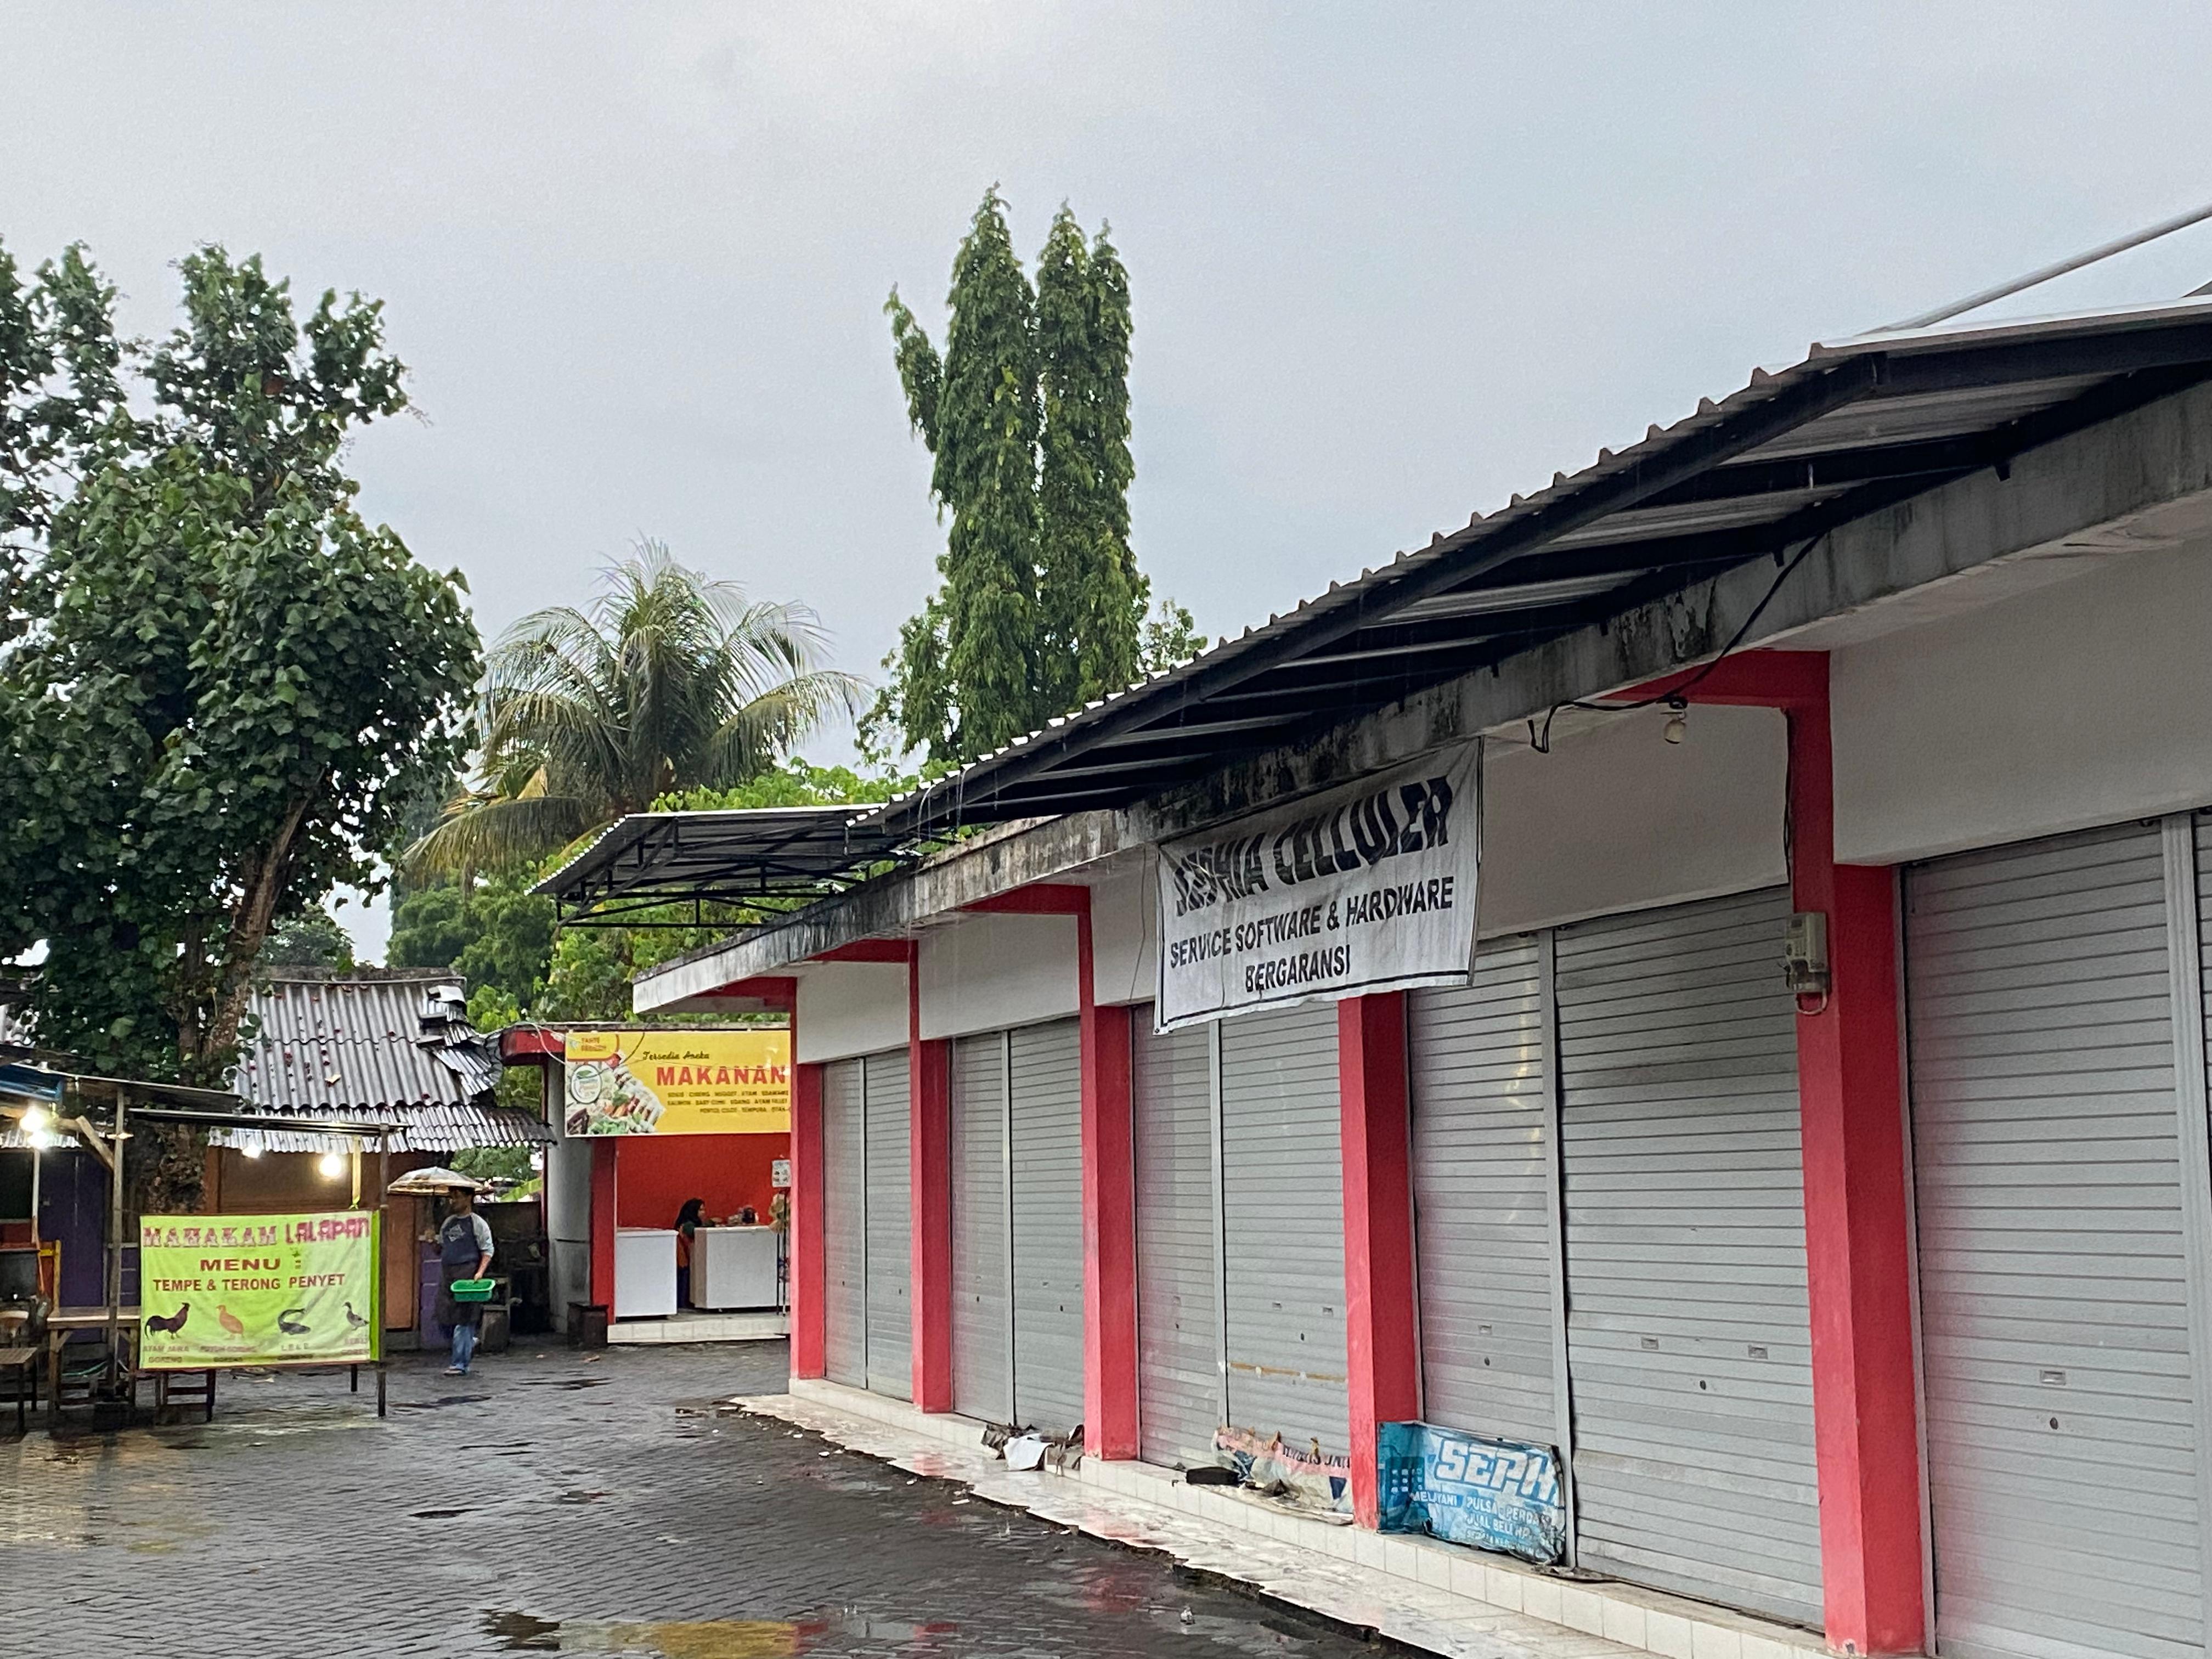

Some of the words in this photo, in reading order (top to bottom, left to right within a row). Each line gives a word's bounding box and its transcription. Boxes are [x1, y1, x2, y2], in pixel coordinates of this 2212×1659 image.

[1272, 776, 1453, 885] CELLULER
[1170, 928, 1231, 968] SERVICE
[1235, 904, 1321, 951] SOFTWARE
[1327, 900, 1340, 930] &
[1346, 876, 1454, 927] HARDWARE
[1245, 944, 1351, 992] BERGARANSI
[656, 1066, 786, 1086] MAKANAN
[200, 1257, 281, 1271] MENU
[153, 1279, 201, 1291] TEMPE
[207, 1279, 216, 1291] &
[222, 1278, 281, 1291] TERONG
[289, 1273, 345, 1288] PENYET
